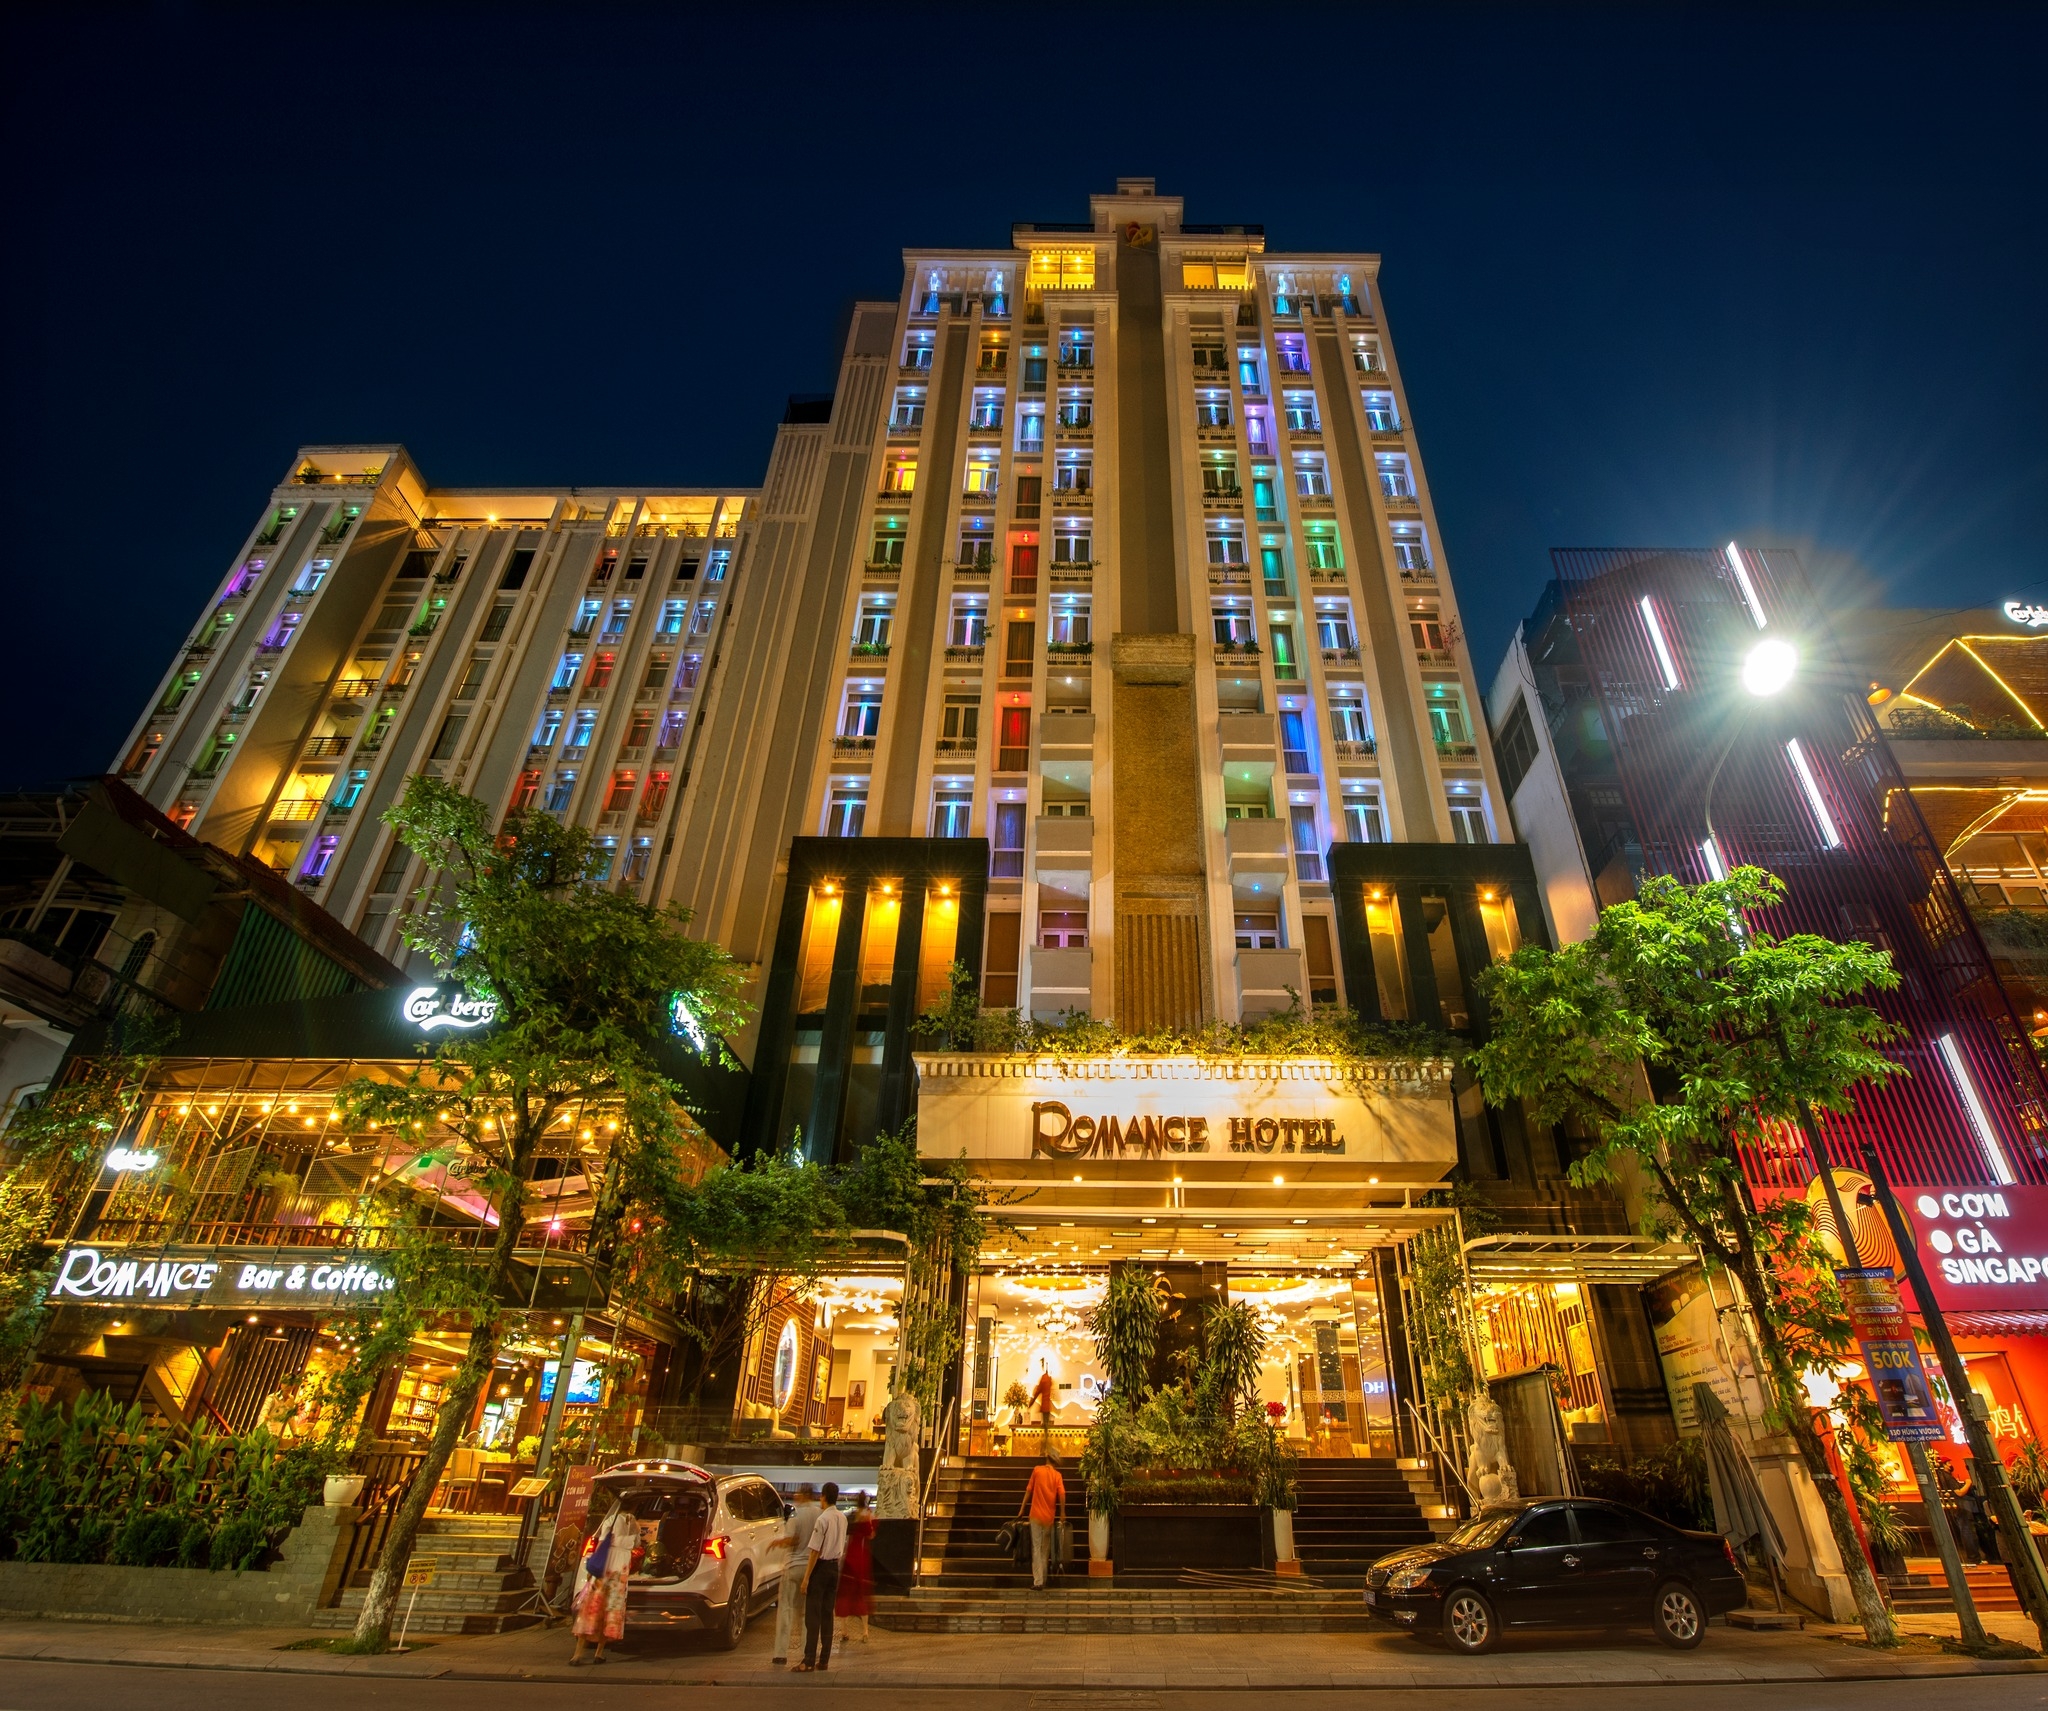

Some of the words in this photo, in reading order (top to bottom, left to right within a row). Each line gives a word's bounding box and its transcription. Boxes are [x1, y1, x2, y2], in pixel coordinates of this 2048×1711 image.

[1031, 1100, 1209, 1153] ROMANCE
[1228, 1117, 1345, 1151] HOTEL
[1942, 1193, 2010, 1218] CƠM
[1956, 1221, 2003, 1254] GÀ
[51, 1249, 218, 1297] ROMANCE
[238, 1264, 282, 1289] Bar
[285, 1265, 305, 1289] &
[1870, 1350, 1915, 1369] 500K
